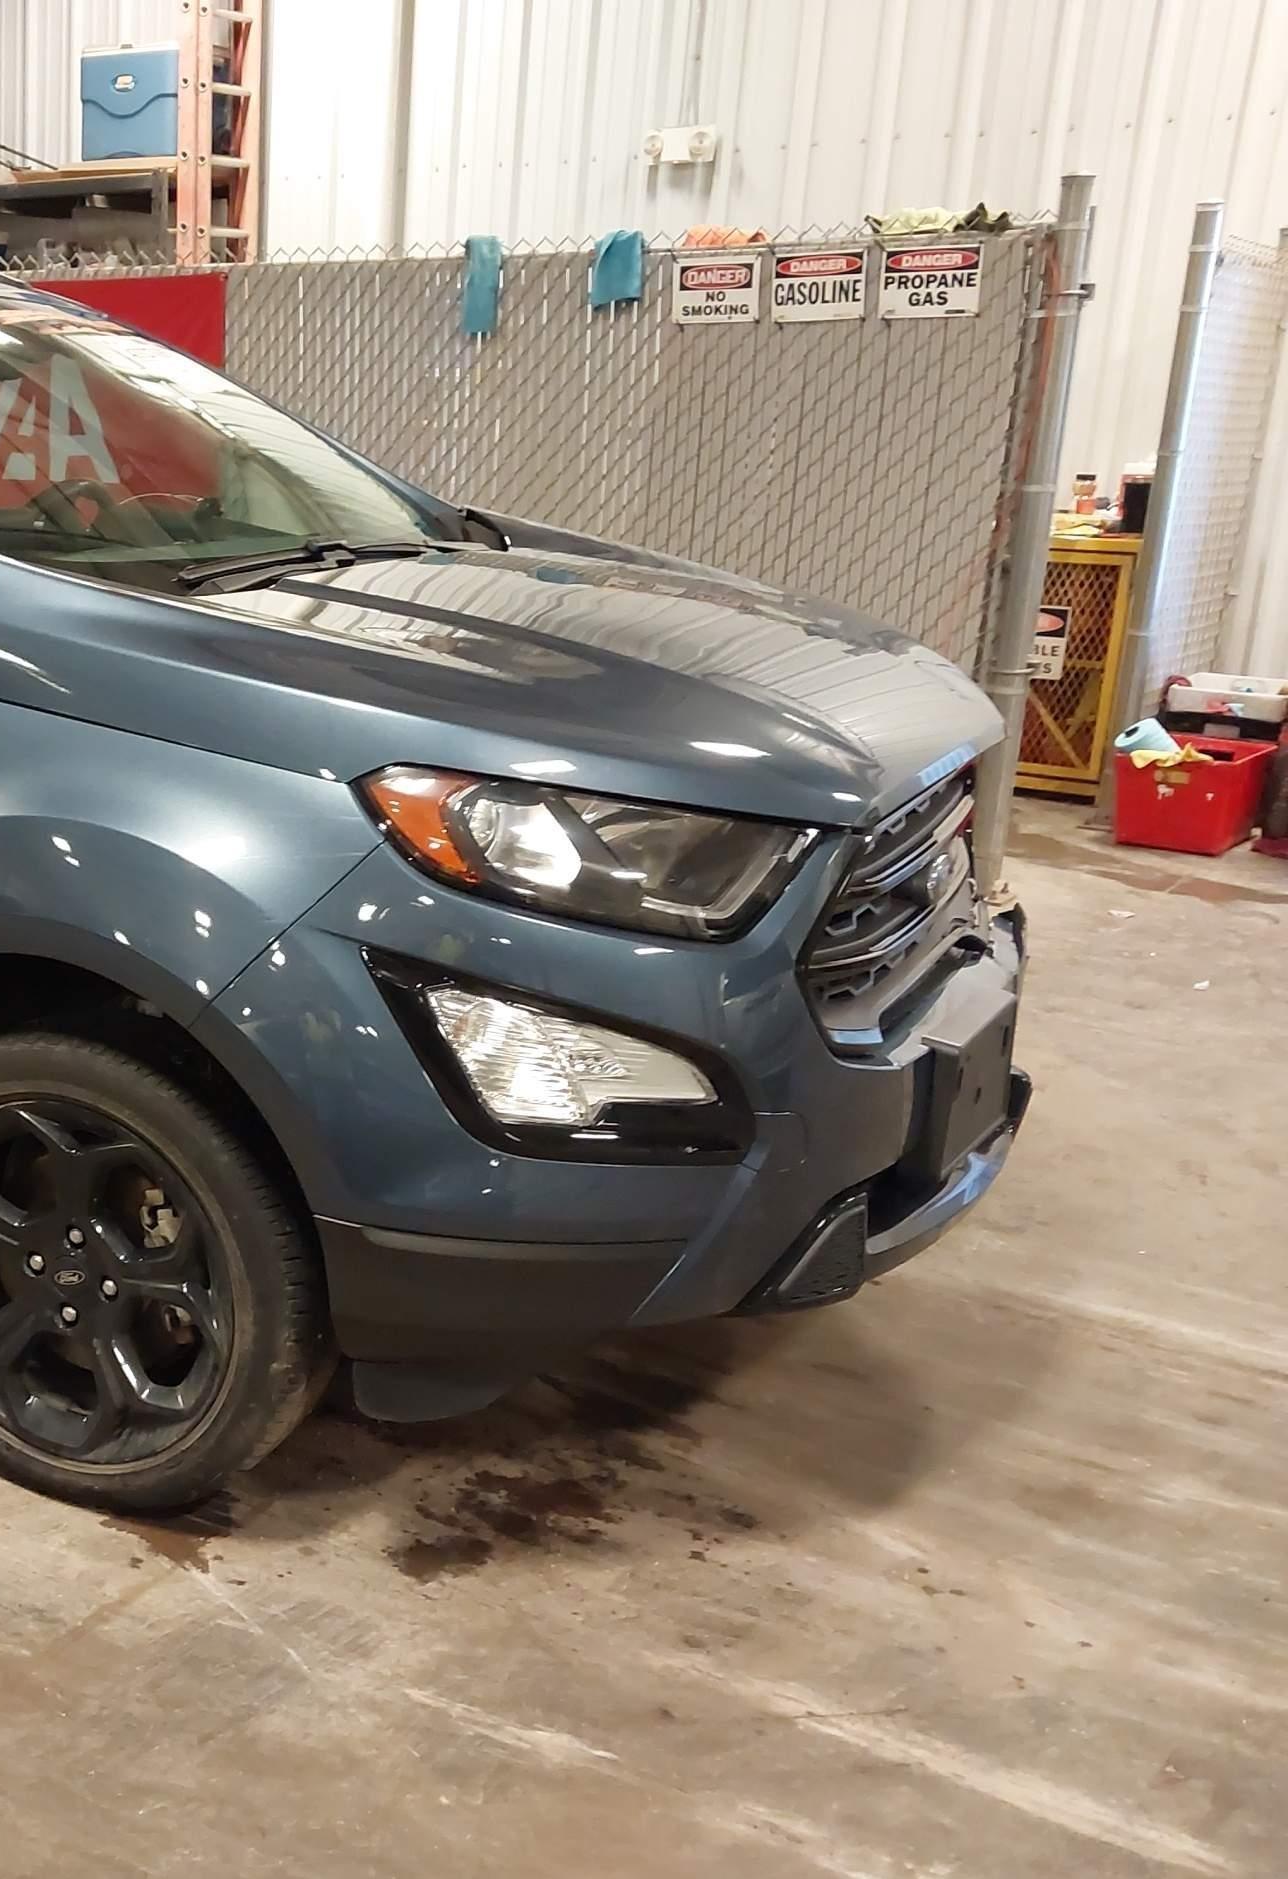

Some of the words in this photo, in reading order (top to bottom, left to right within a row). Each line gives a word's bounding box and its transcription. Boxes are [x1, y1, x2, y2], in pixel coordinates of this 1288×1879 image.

[790, 258, 847, 272] DANGER
[900, 253, 963, 266] DANGER
[687, 269, 746, 285] DANGER
[883, 272, 978, 291] PROPANE
[705, 290, 727, 303] NO
[774, 279, 862, 306] GASOLINE
[908, 291, 949, 307] GAS
[681, 303, 750, 317] SMOKING
